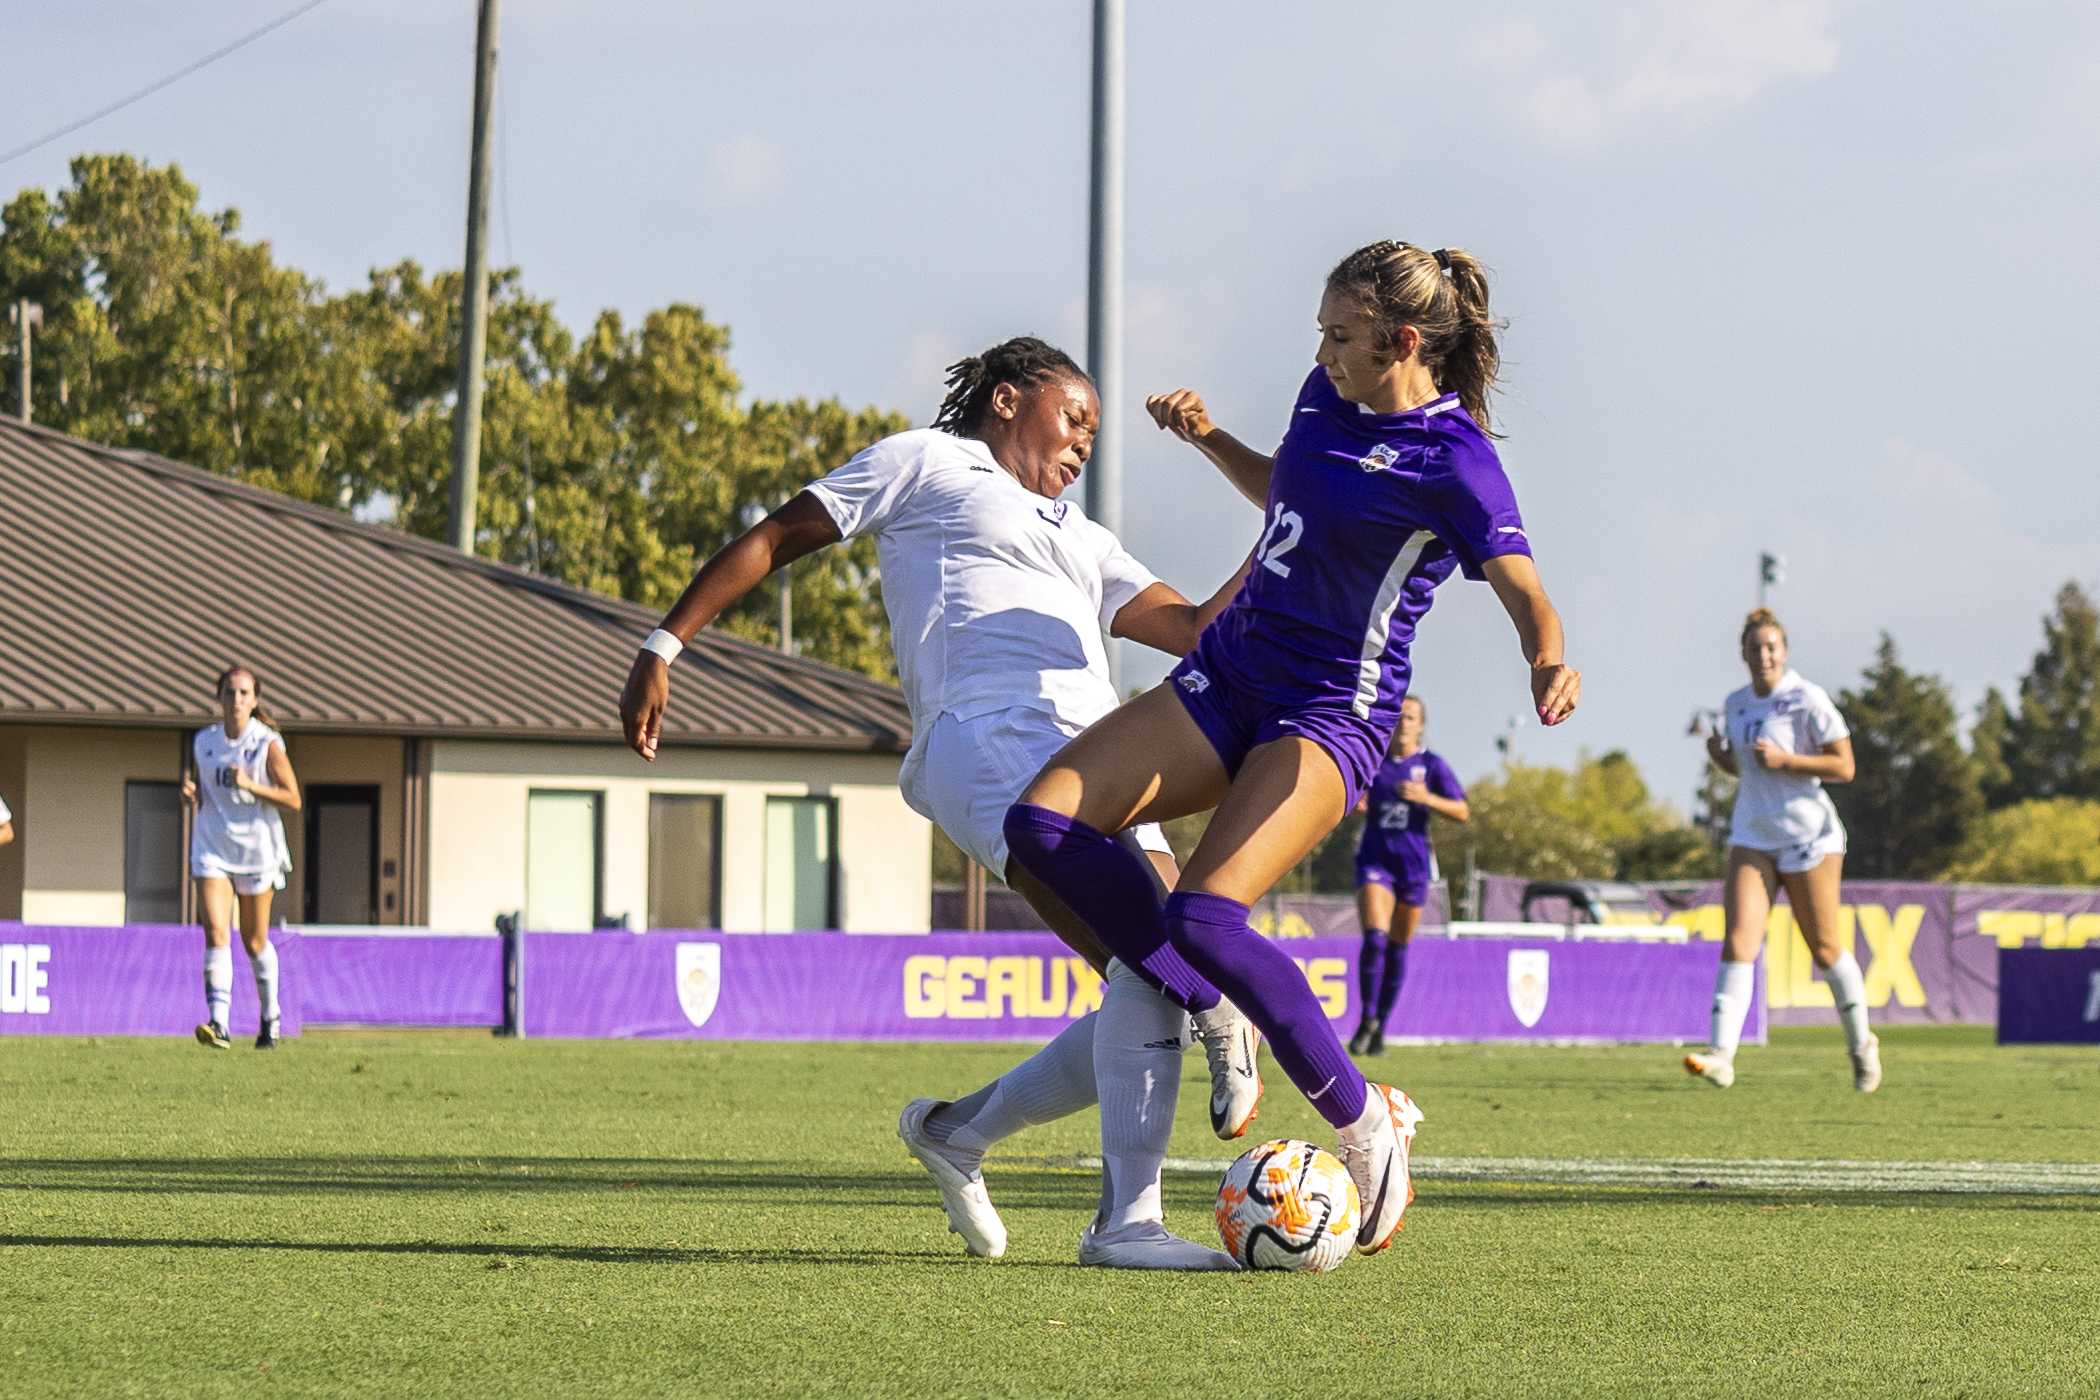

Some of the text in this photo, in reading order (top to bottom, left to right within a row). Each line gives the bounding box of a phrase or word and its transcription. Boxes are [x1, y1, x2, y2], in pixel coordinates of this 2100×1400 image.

[1257, 501, 1304, 578] 12
[0, 944, 51, 1014] DE
[904, 955, 1105, 1019] GEAUX
